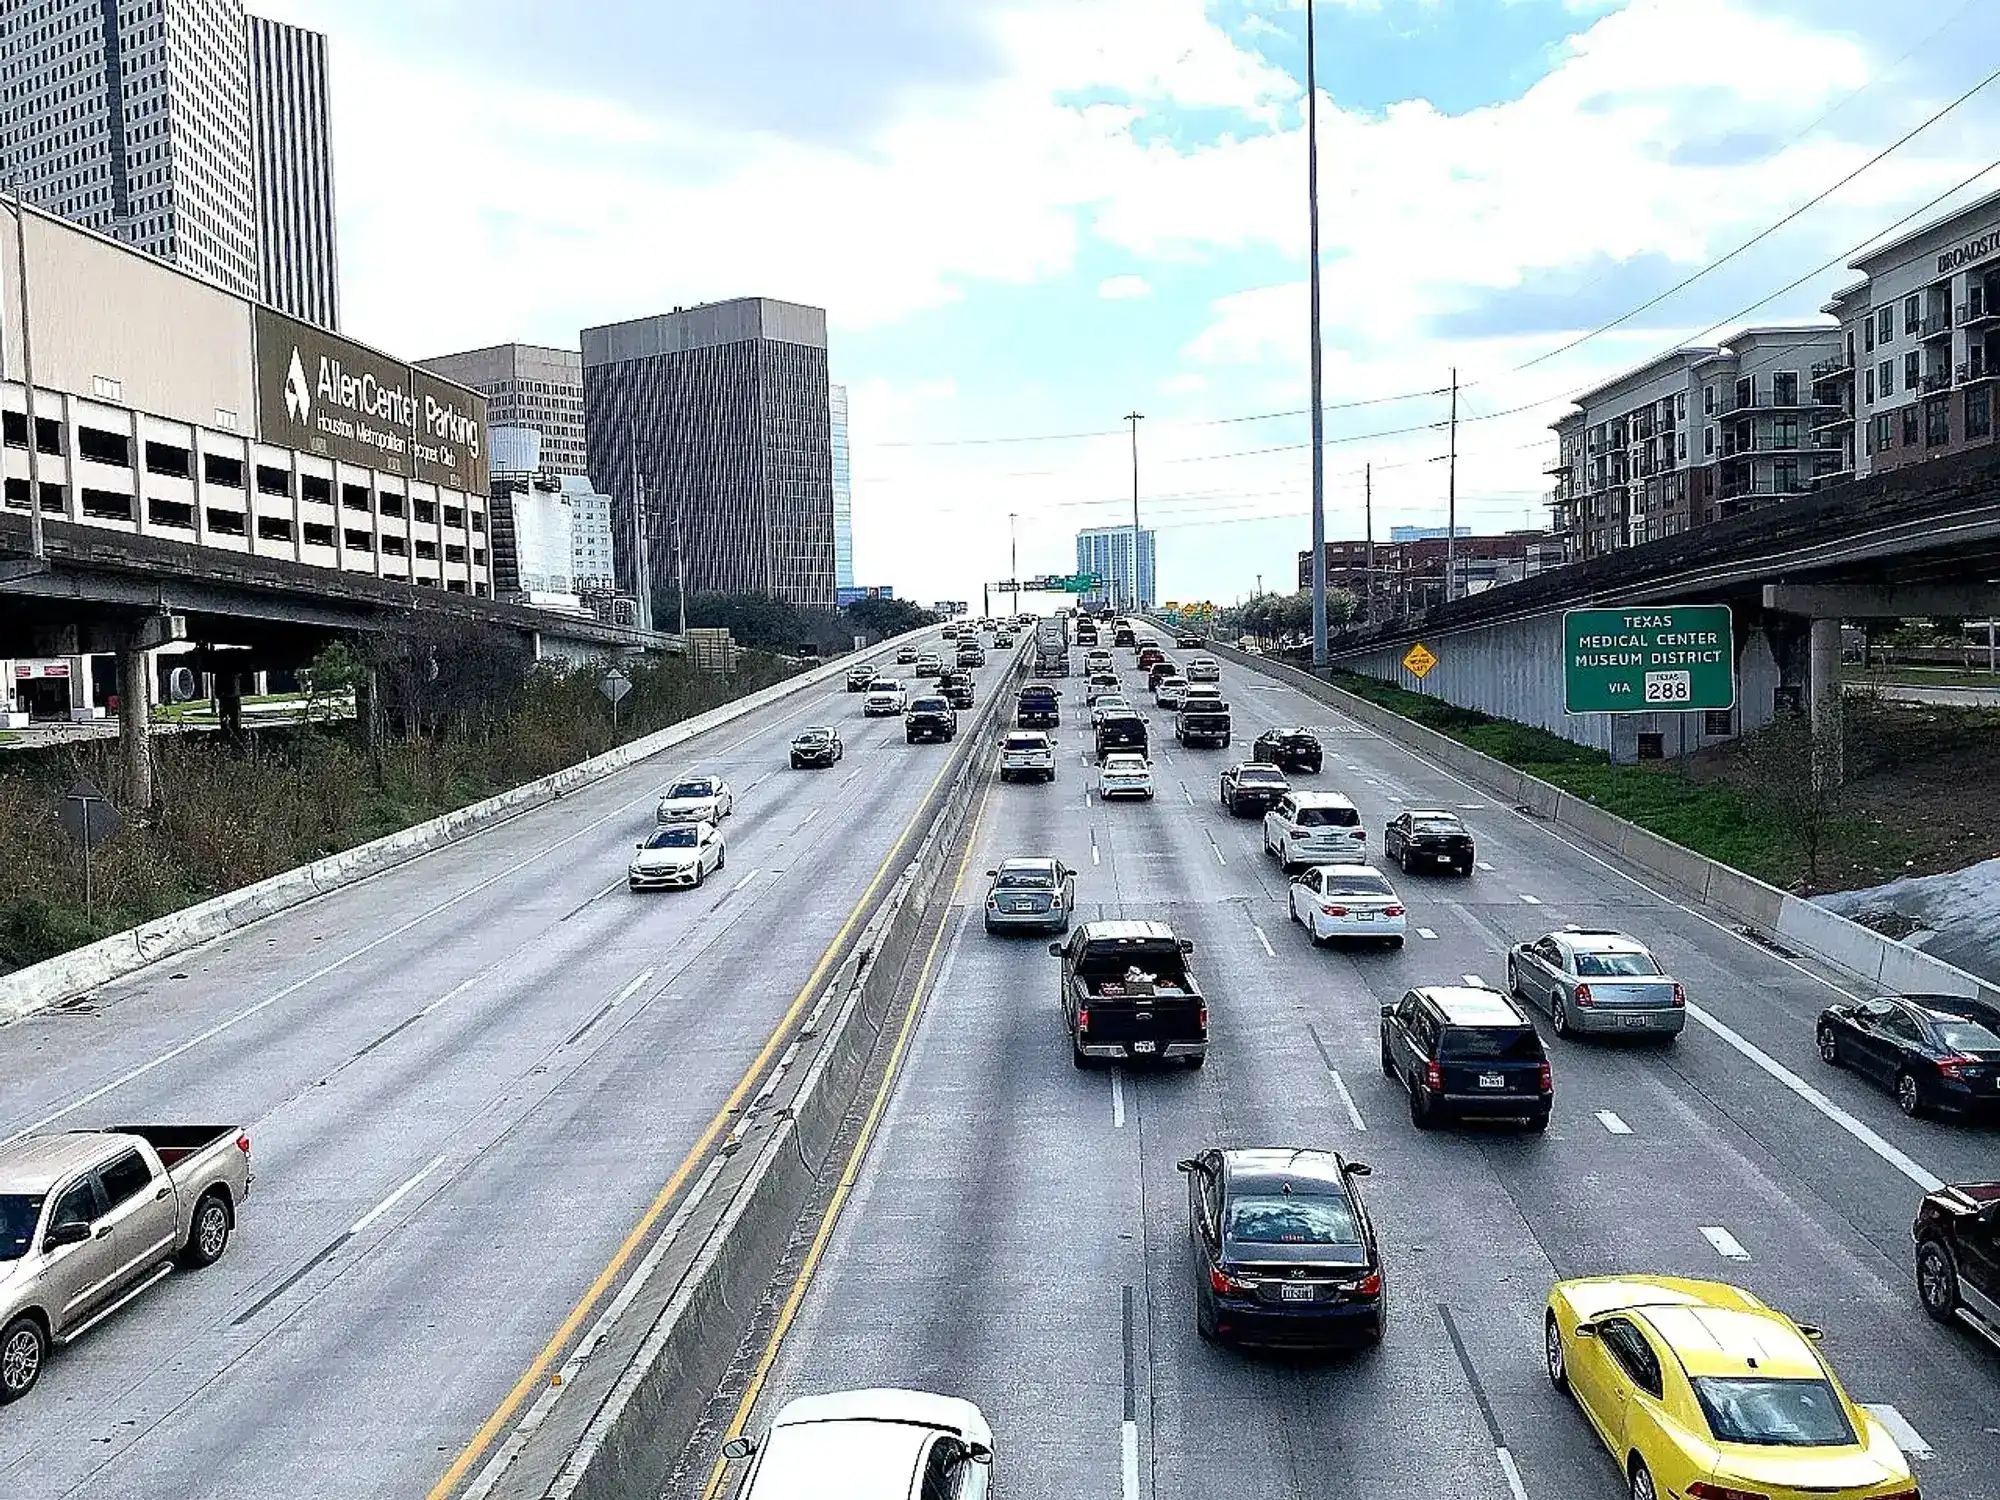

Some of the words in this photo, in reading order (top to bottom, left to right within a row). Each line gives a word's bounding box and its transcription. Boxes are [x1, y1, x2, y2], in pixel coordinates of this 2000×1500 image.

[424, 394, 479, 459] Parking
[316, 407, 354, 439] Houston
[356, 420, 406, 455] Metropolitan
[440, 445, 456, 468] Club
[1623, 615, 1672, 628] TEXAS
[1579, 634, 1648, 648] MEDICAL
[1656, 632, 1717, 645] CENTER
[1575, 652, 1642, 667] MUSEUM
[1651, 650, 1722, 664] DISTRICT
[1656, 673, 1680, 681] TEXAS
[1608, 682, 1631, 693] VIA
[1648, 682, 1687, 700] 288
